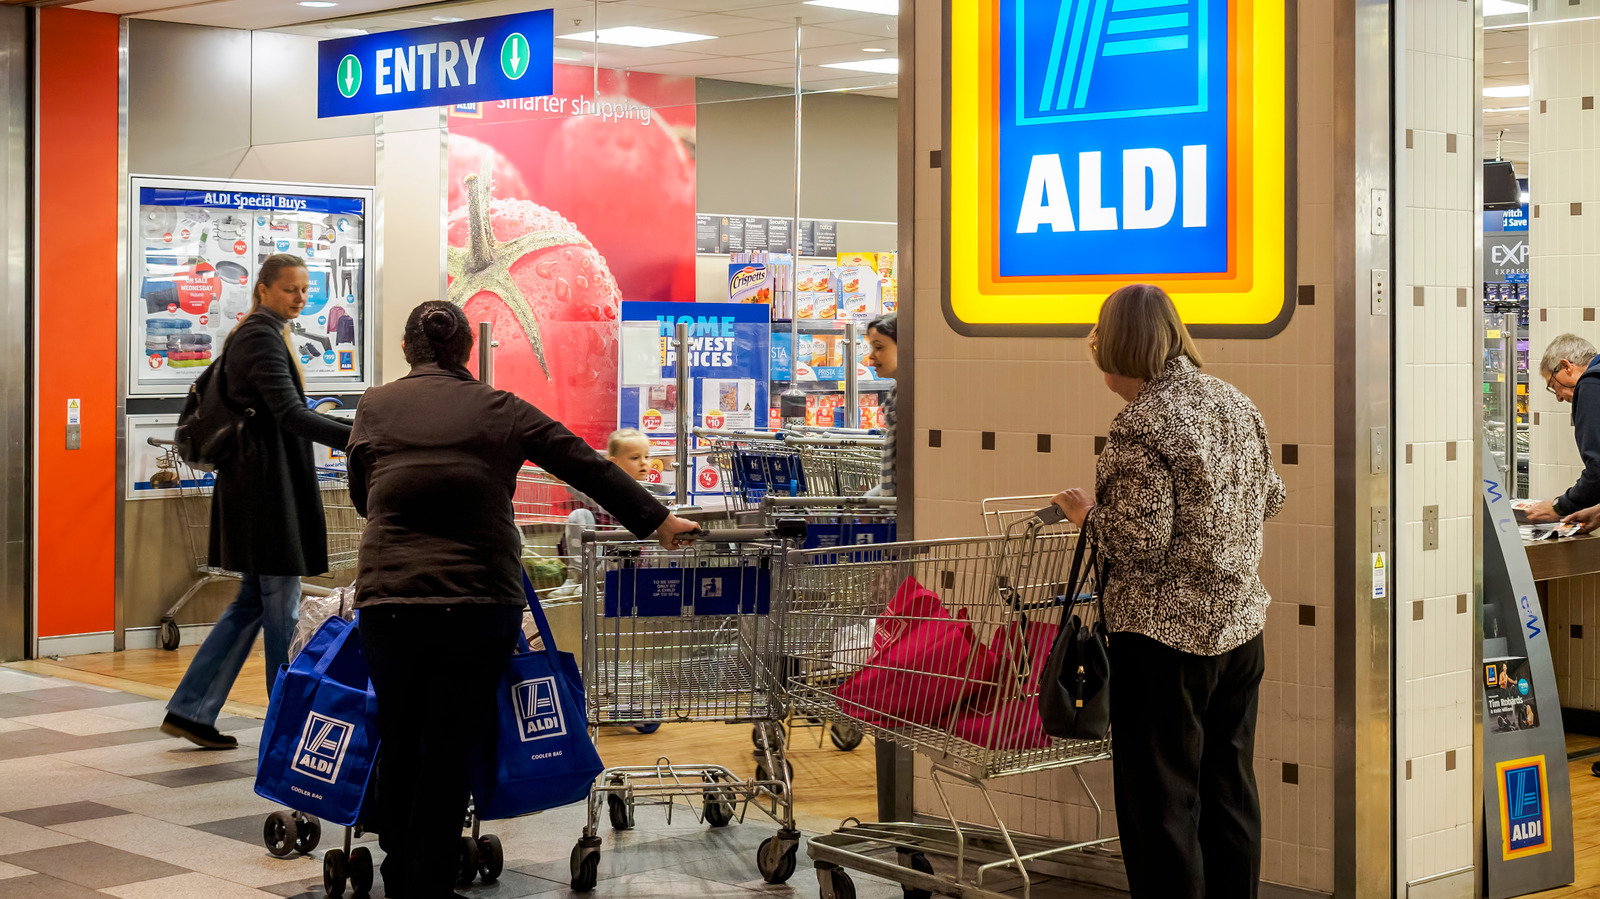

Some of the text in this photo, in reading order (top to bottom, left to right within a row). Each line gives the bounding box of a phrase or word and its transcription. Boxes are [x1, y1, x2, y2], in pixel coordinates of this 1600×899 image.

[375, 37, 485, 95] ENTRY
[497, 95, 652, 125] smarter shopping
[1015, 144, 1207, 234] ALDI
[204, 192, 307, 212] ALDI Special Buys
[1508, 218, 1527, 227] Save
[733, 270, 766, 290] Crispetts
[656, 315, 735, 337] HOME
[667, 337, 735, 351] LWEST
[818, 368, 836, 376] PRISTA
[708, 419, 720, 428] $10
[703, 473, 712, 482] $4
[1489, 698, 1501, 709] Tim
[527, 716, 559, 734] ALDI
[531, 750, 563, 760] COOLER BAG
[299, 754, 334, 775] ALDI
[290, 785, 323, 801] COOLER BAG
[1511, 820, 1541, 842] ALDI
